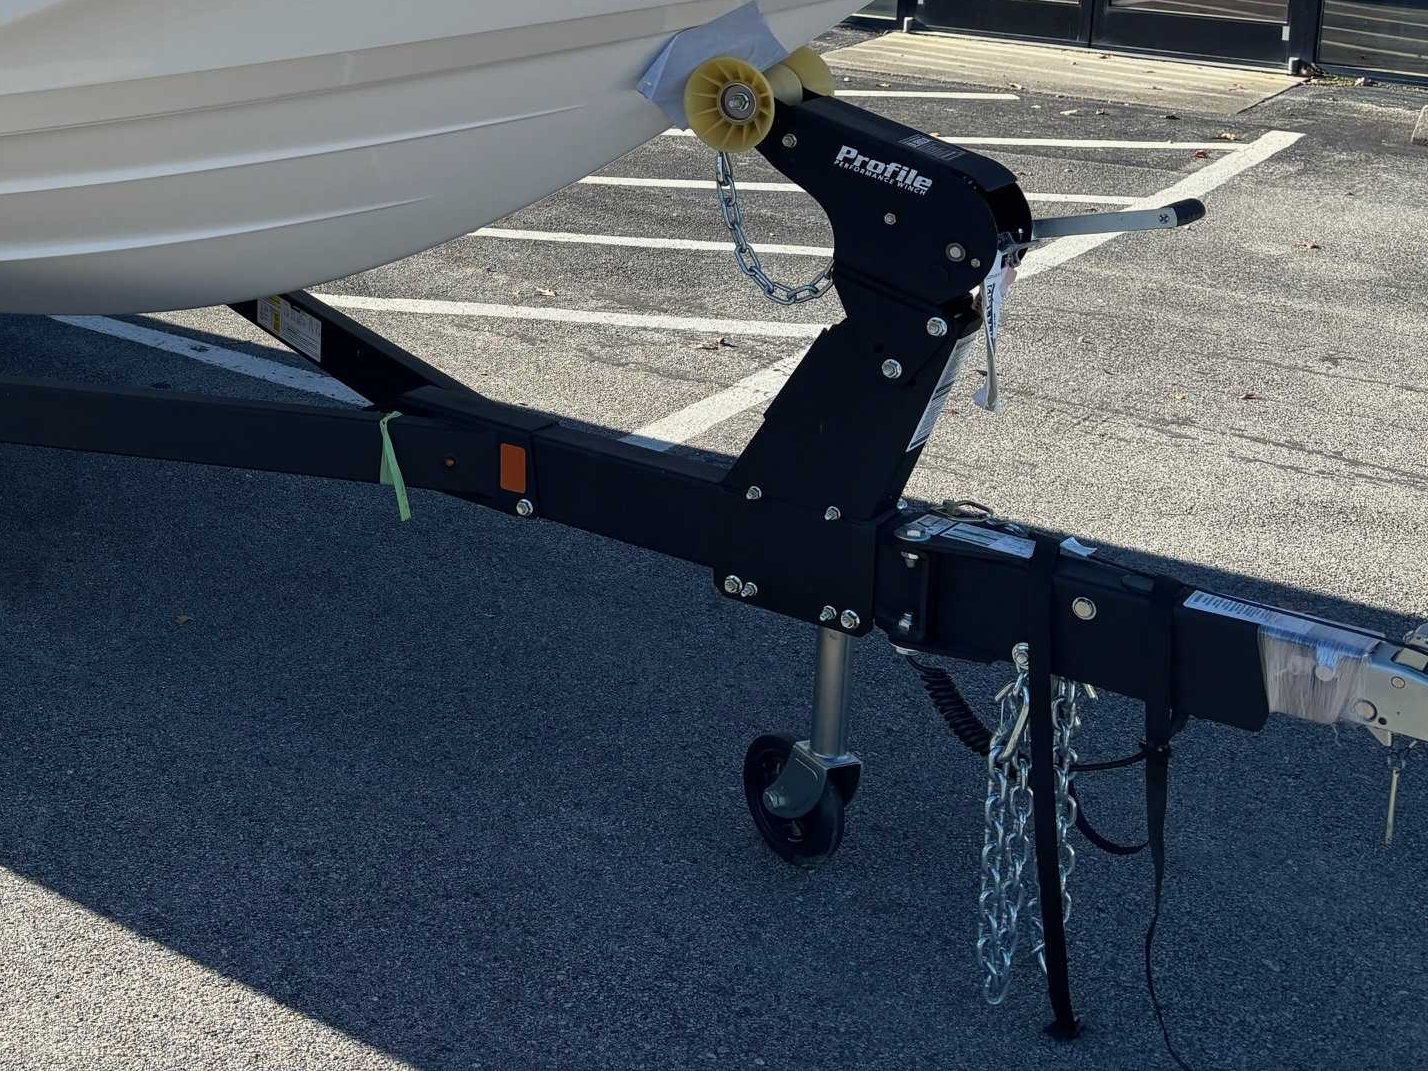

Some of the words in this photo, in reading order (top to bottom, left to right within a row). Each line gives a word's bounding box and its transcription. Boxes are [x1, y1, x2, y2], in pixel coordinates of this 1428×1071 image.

[834, 160, 894, 186] PERFORMANCE
[897, 181, 927, 196] WINCH
[836, 145, 932, 190] Profile
